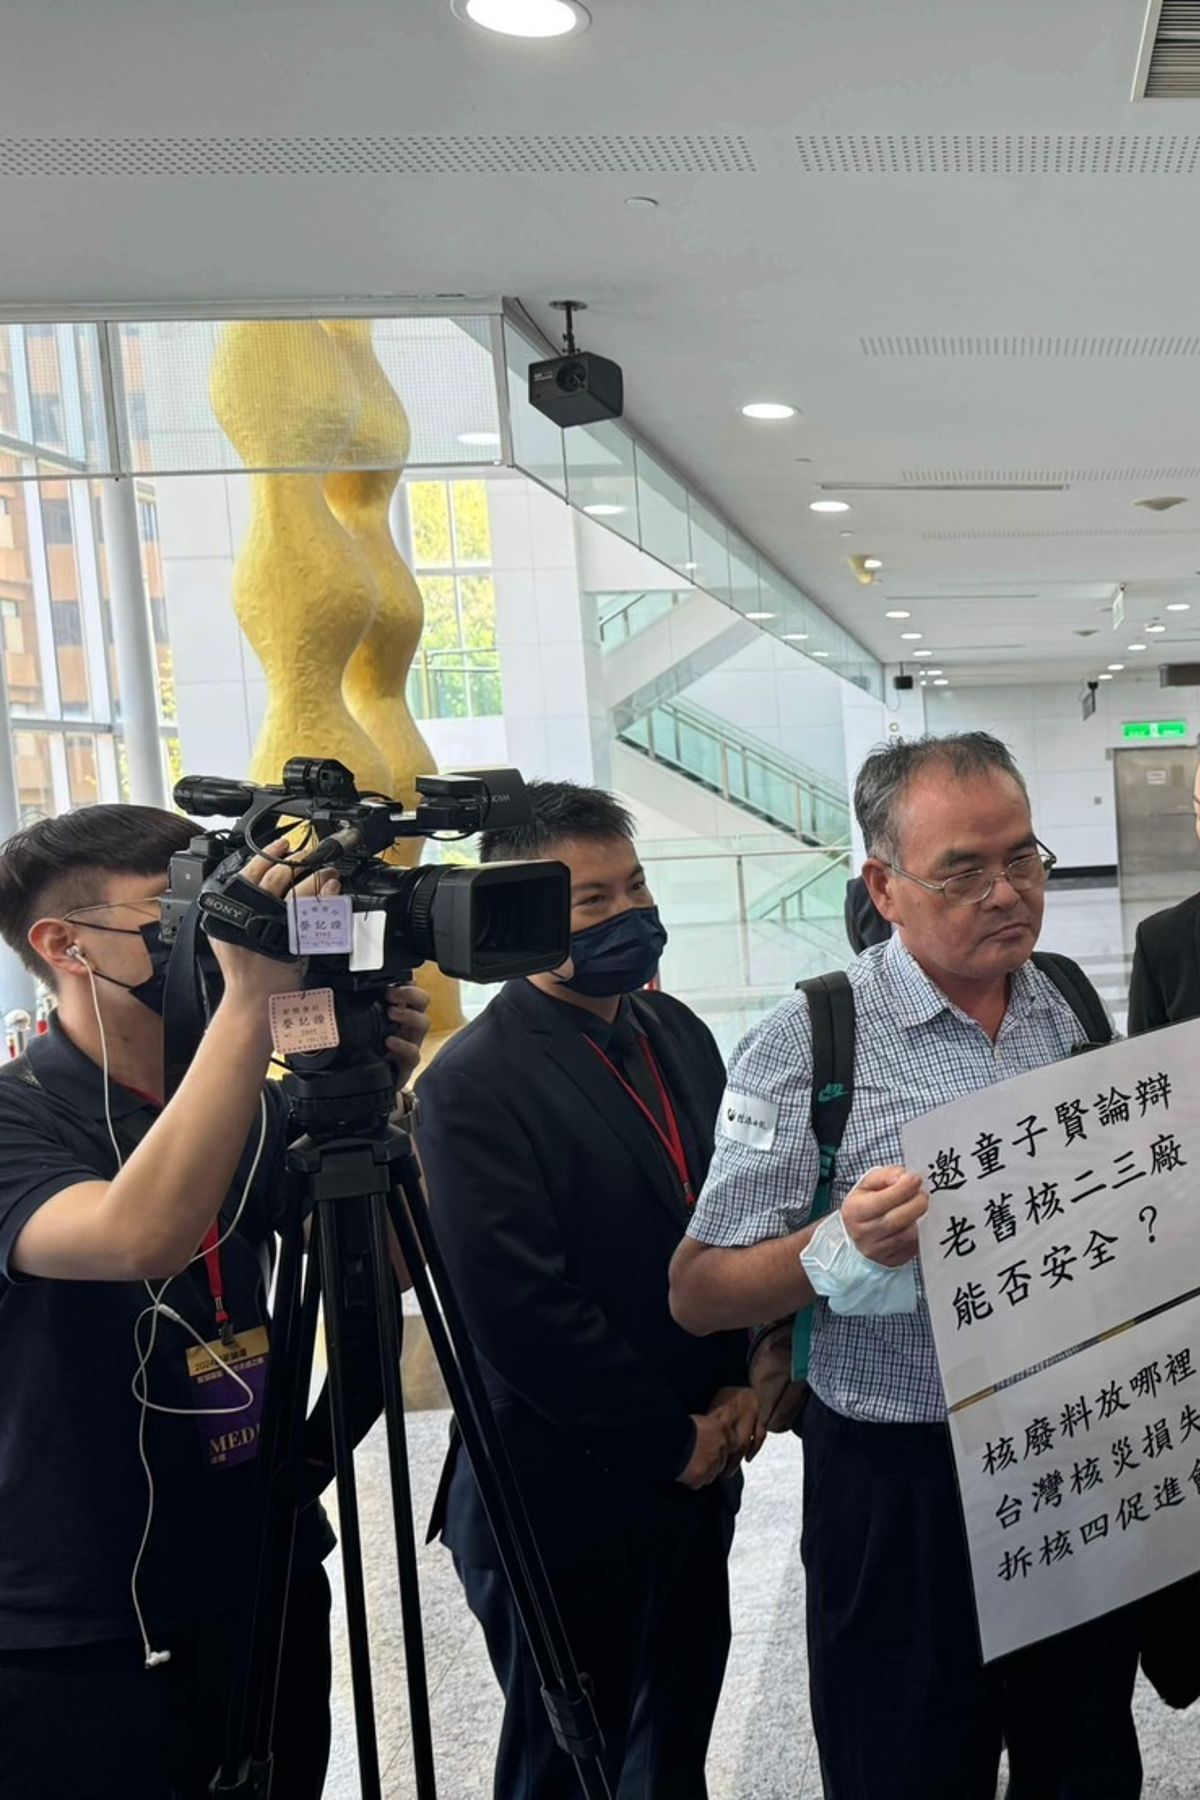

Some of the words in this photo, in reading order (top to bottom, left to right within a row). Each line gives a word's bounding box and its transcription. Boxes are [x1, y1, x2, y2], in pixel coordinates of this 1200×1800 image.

[204, 897, 242, 918] SONY
[927, 1071, 1173, 1194] 邀童子賢論辯
[939, 1133, 1188, 1260] 老舊核二三廠
[951, 1204, 1159, 1330] 能否安全？
[981, 1347, 1198, 1475] 核廢料放哪裡
